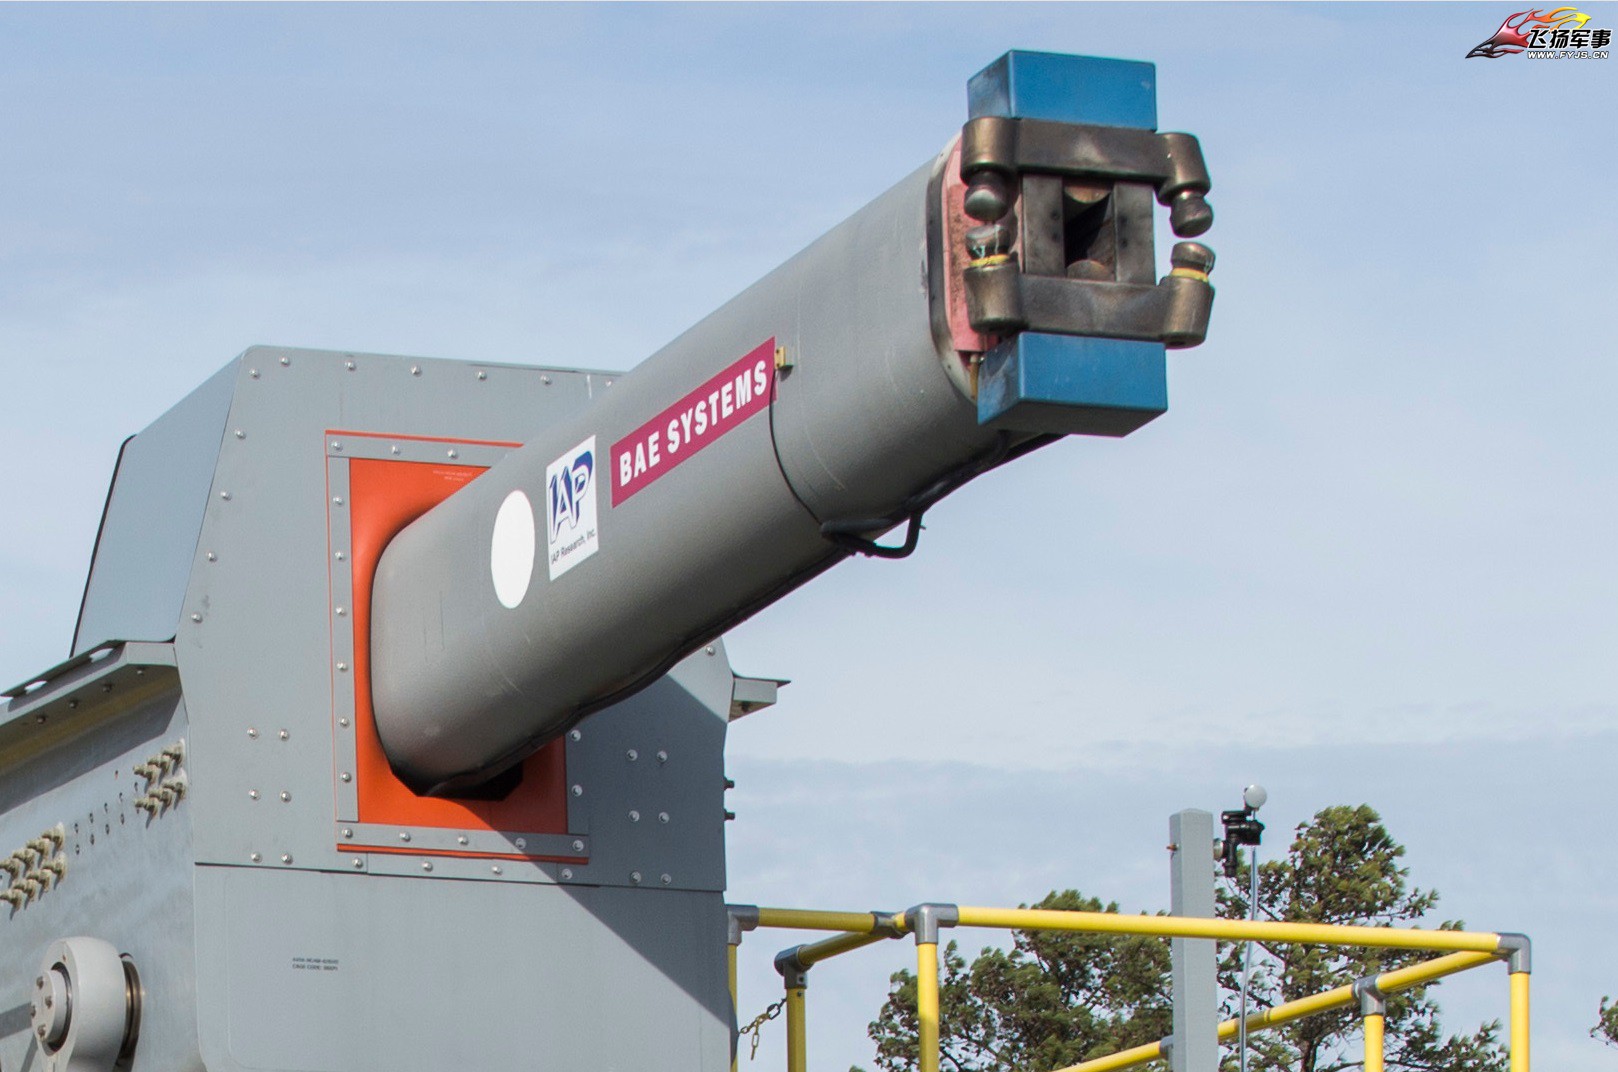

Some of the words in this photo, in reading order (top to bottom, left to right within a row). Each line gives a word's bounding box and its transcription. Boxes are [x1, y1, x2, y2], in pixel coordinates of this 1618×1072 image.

[619, 431, 660, 487] BAE
[667, 360, 767, 454] SYSTEMS
[549, 450, 593, 544] IAP
[551, 549, 560, 565] IAP
[561, 535, 586, 557] Research,
